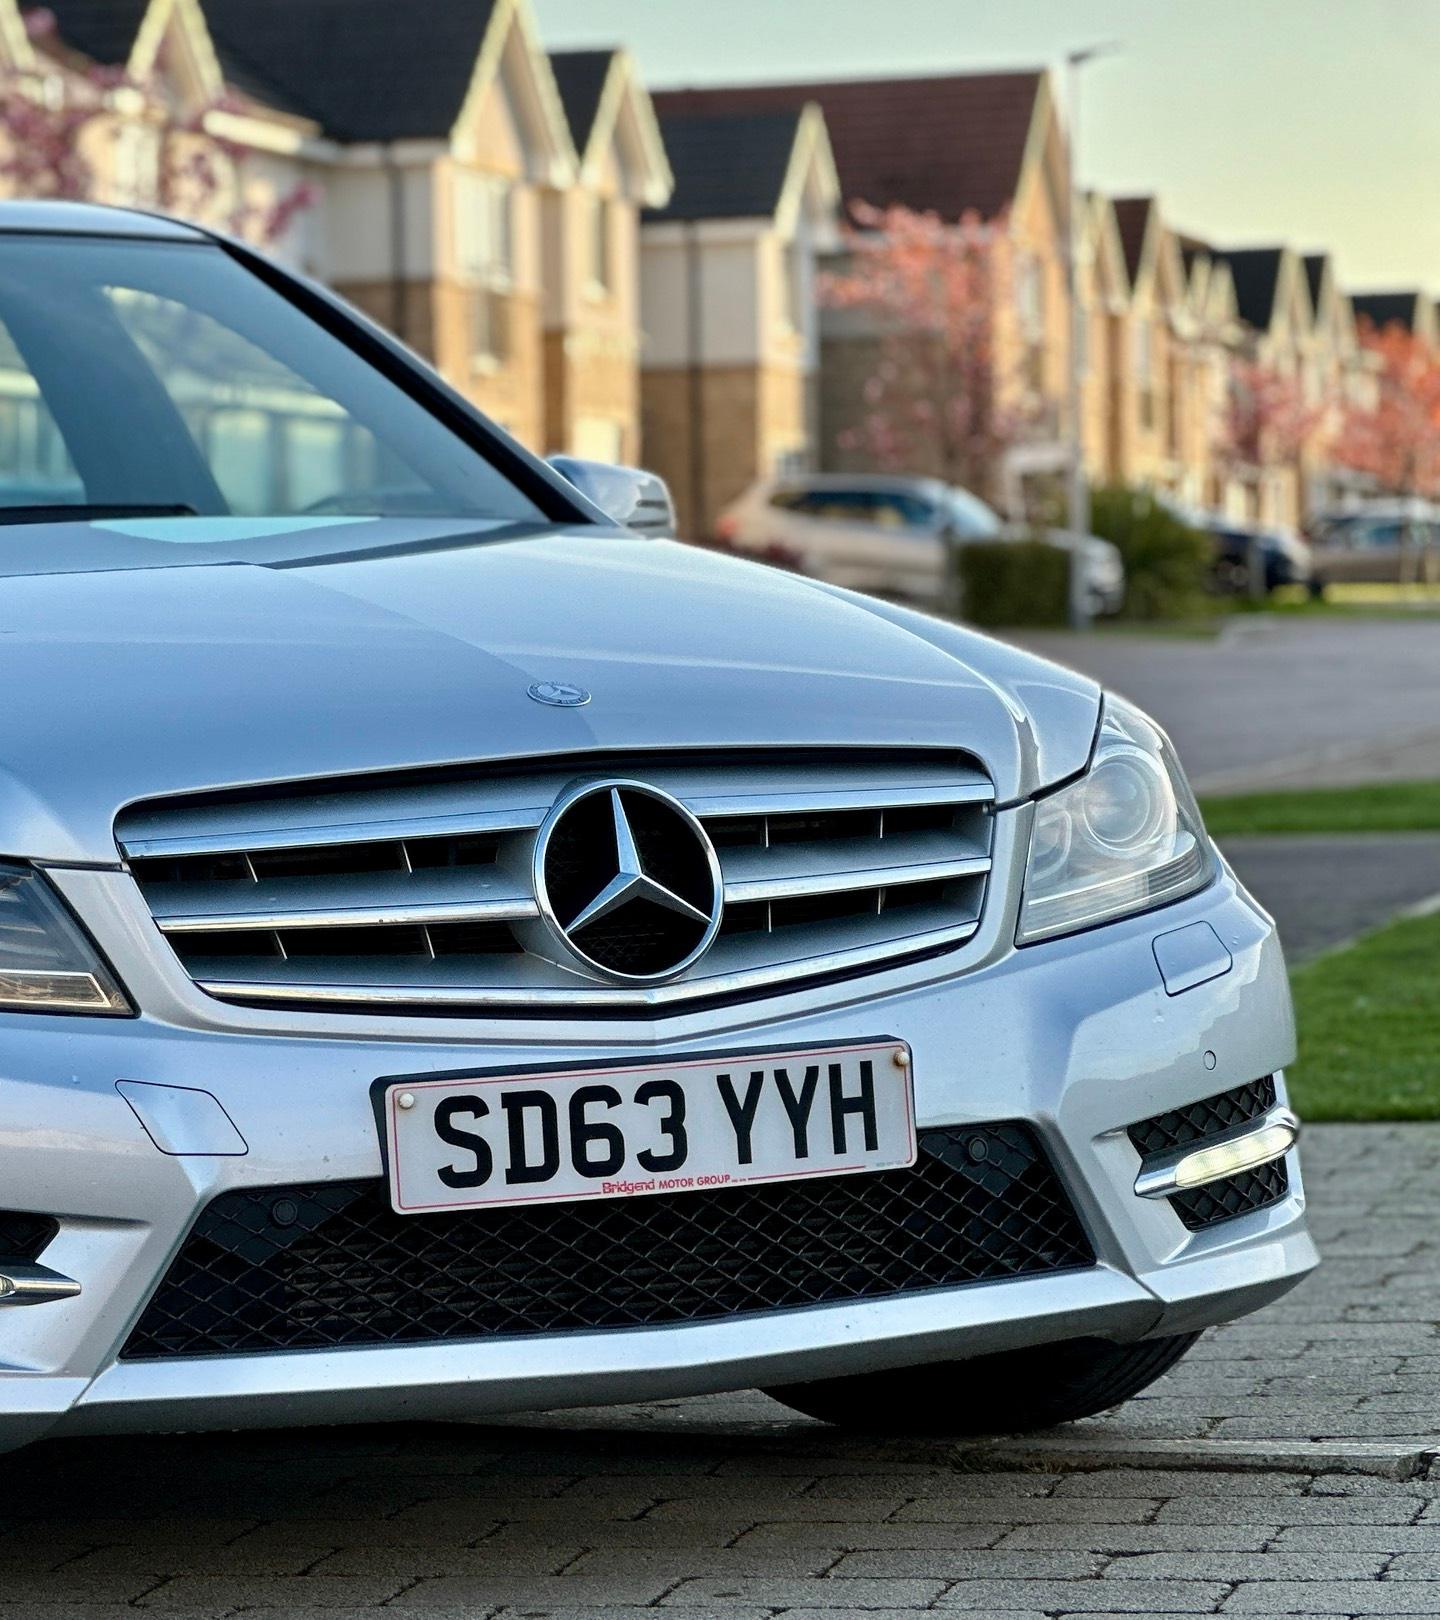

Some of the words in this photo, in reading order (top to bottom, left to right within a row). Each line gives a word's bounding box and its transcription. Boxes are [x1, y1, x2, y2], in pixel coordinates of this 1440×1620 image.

[433, 1079, 688, 1189] SD63
[716, 1059, 879, 1165] YYH
[602, 1178, 655, 1195] Bridgend
[658, 1177, 694, 1189] MOTOR
[697, 1174, 731, 1186] GROUP
